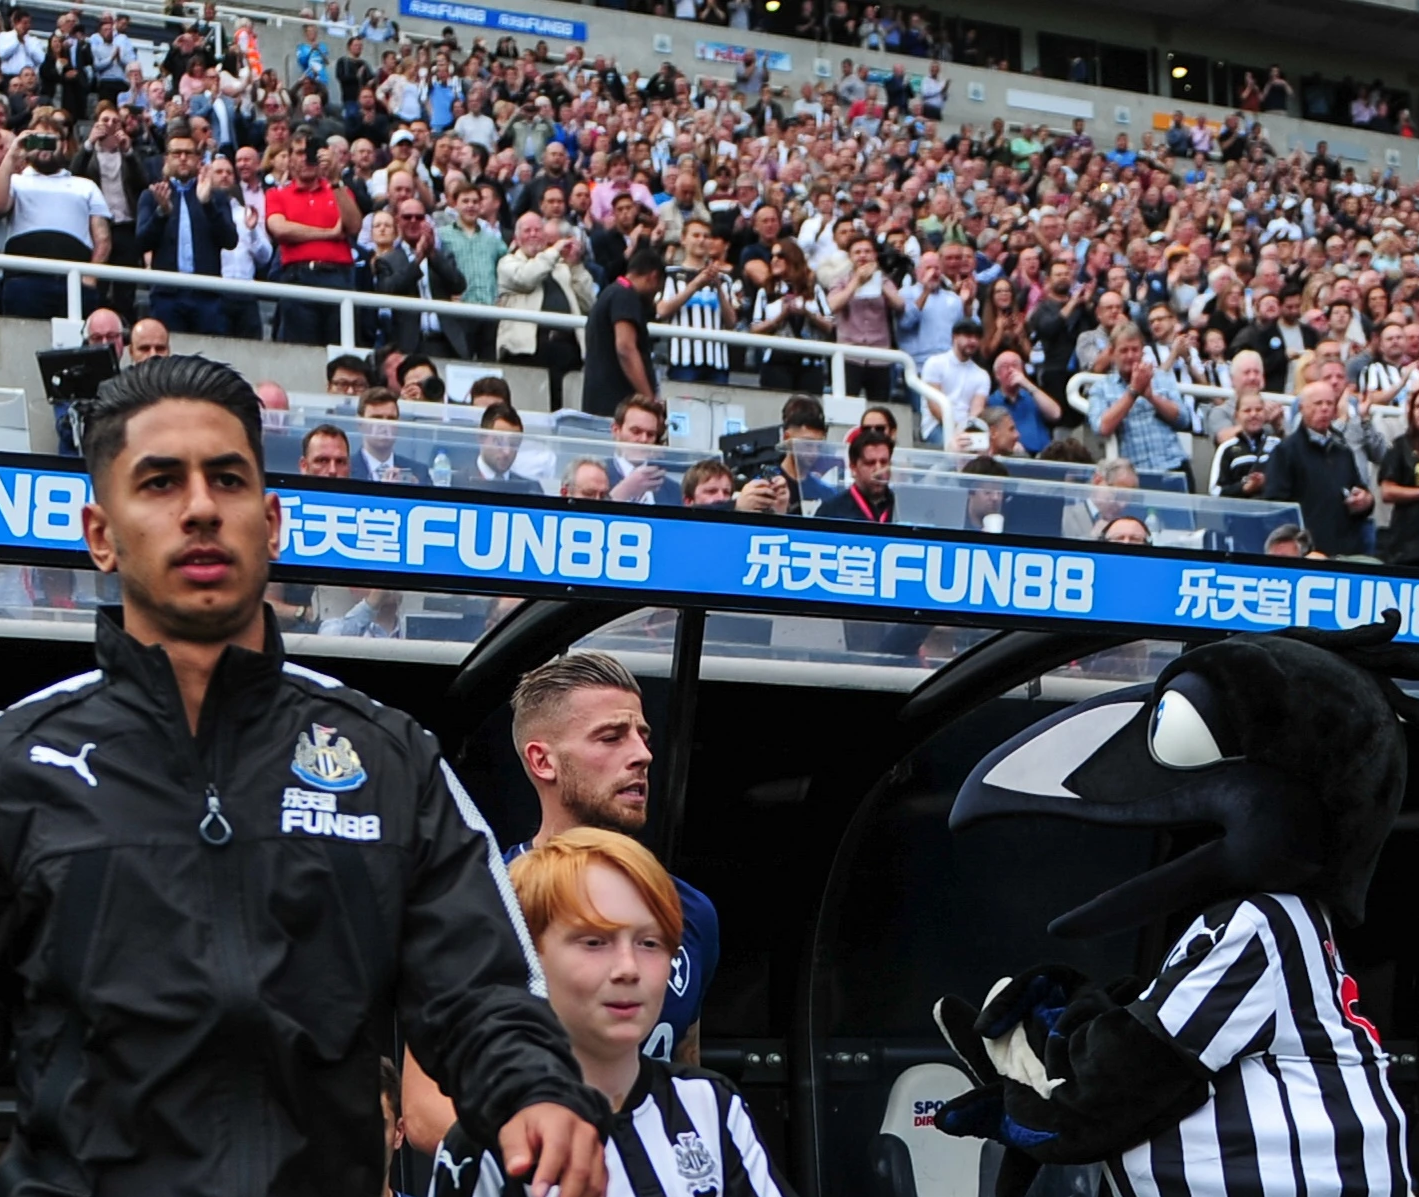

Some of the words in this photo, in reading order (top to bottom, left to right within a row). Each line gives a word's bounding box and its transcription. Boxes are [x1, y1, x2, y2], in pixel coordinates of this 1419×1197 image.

[407, 506, 652, 582] FUN88
[881, 544, 1095, 613] FUN88
[282, 809, 381, 841] FUN88
